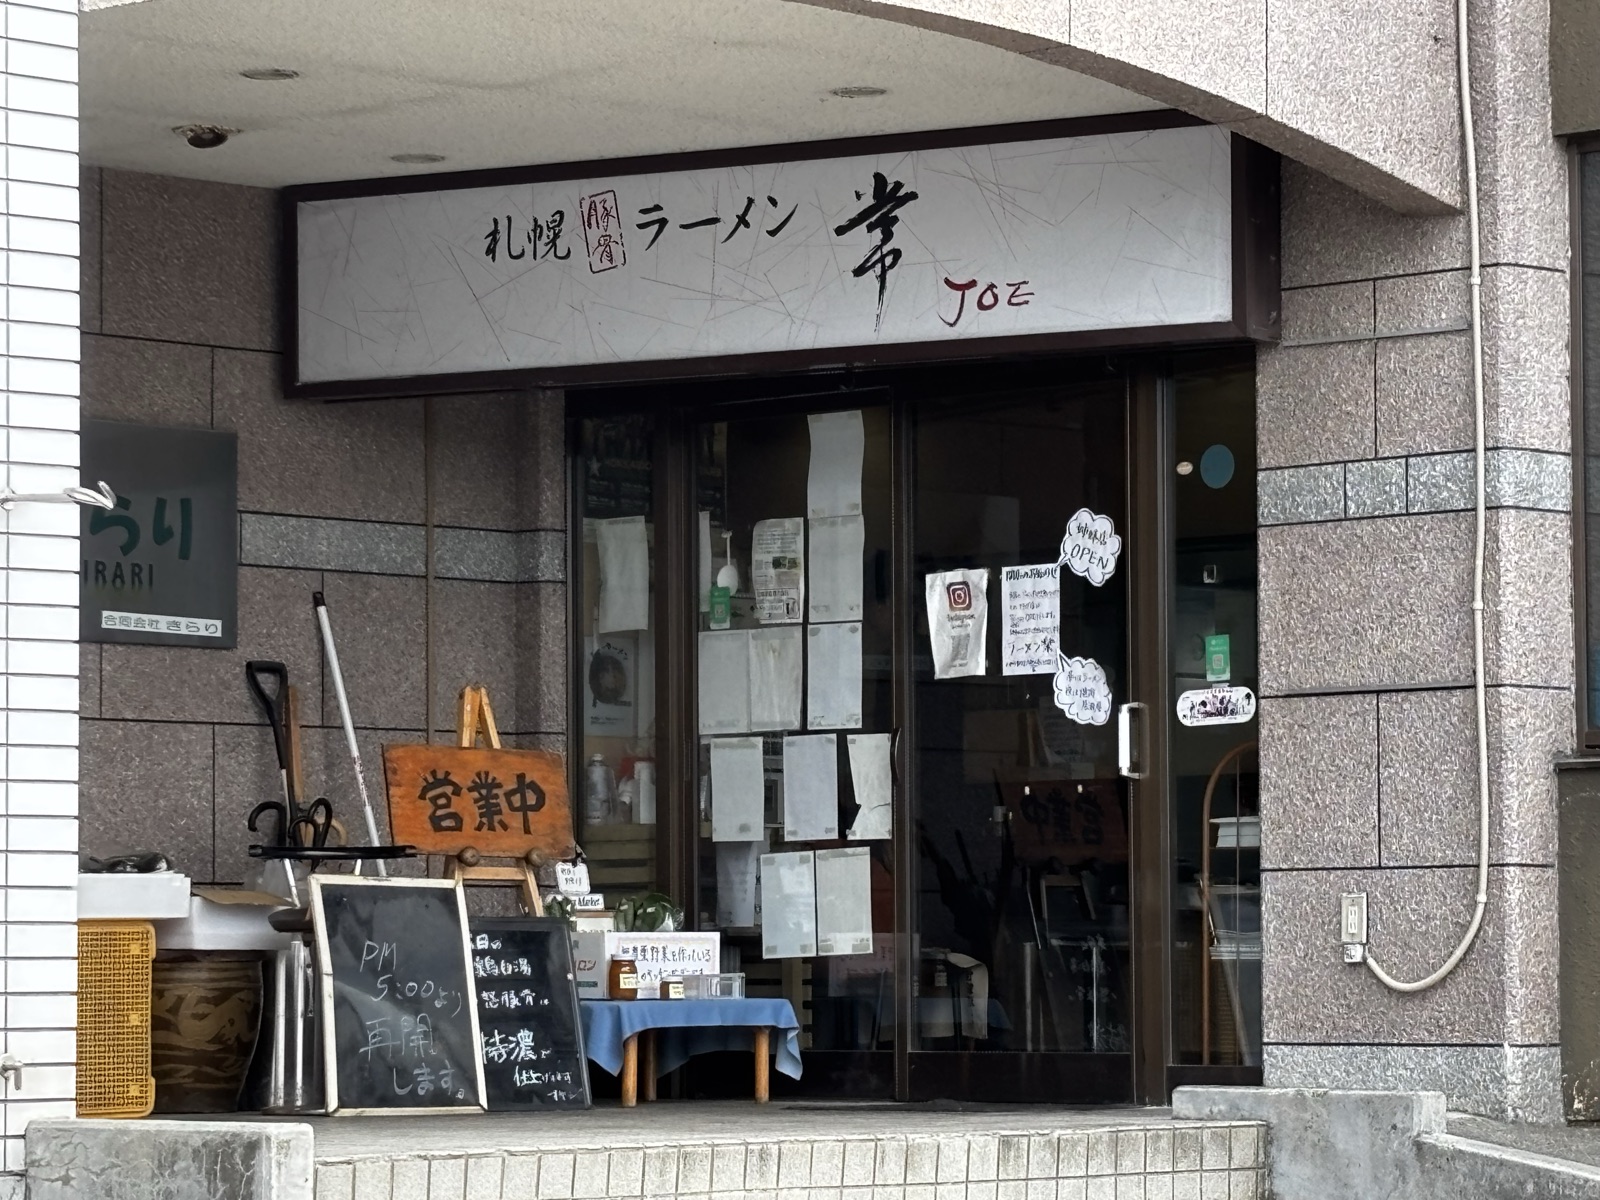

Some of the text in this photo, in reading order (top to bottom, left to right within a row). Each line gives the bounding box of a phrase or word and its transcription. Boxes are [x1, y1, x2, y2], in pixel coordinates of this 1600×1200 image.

[484, 171, 919, 335] 札幌 豚骨 ラーメン 常
[936, 276, 1035, 327] JOE
[1070, 543, 1109, 570] OPEN
[417, 768, 547, 835] 営業中
[360, 940, 397, 973] PM
[358, 1012, 438, 1062] 再開
